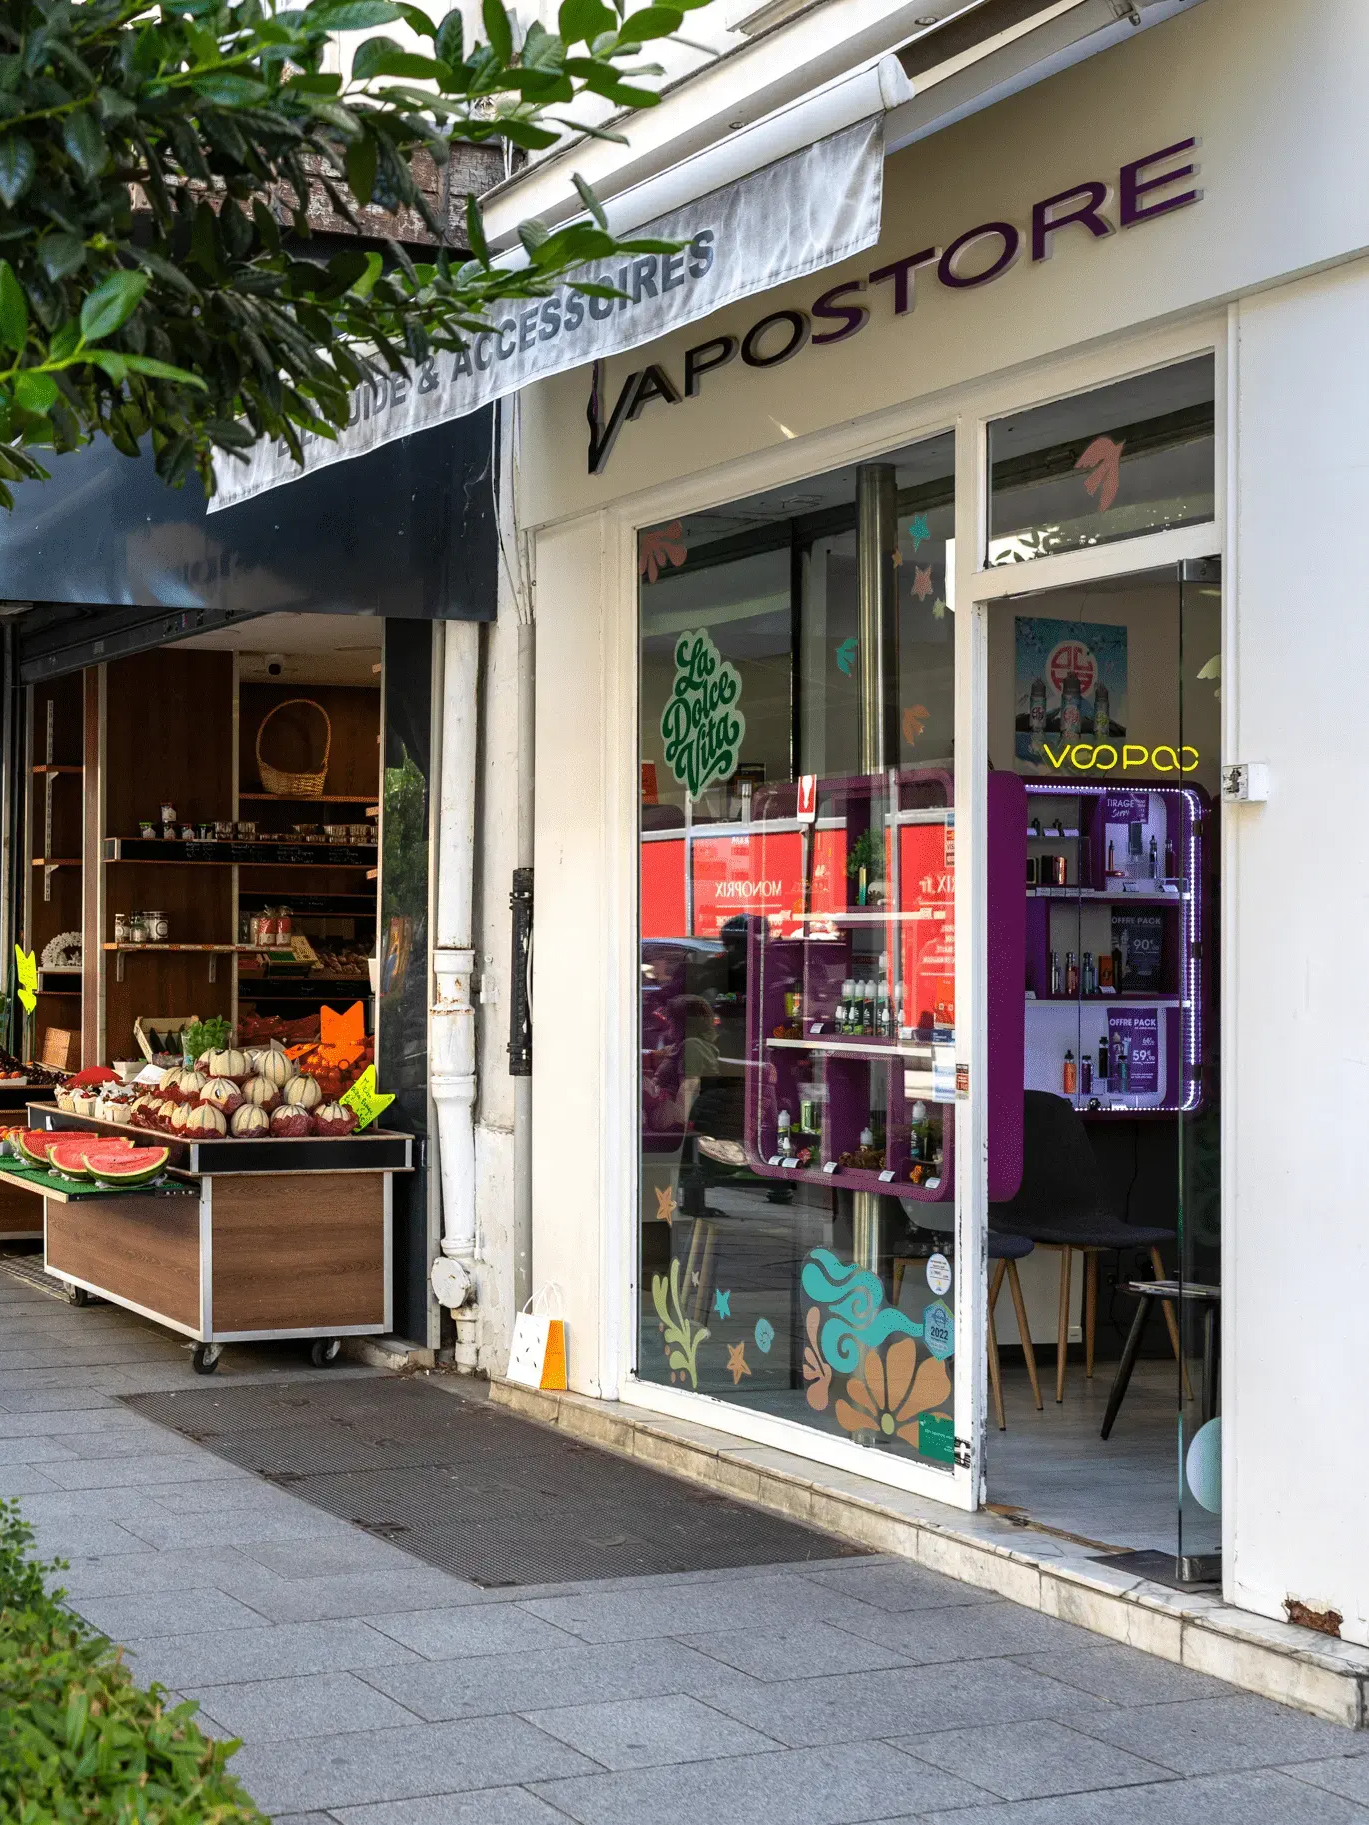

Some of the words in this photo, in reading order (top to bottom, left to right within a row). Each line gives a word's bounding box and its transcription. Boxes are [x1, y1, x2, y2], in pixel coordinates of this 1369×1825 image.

[417, 364, 441, 394] &
[451, 228, 715, 384] ACCESSOIRES
[587, 136, 1204, 476] VAPOSTORE
[676, 637, 715, 697] La
[662, 671, 737, 762] Dolce
[674, 711, 740, 797] Vita
[1111, 916, 1135, 925] OFFRE
[1137, 917, 1161, 926] PACK
[1109, 1018, 1133, 1027] OFFRE
[1134, 1018, 1156, 1027] PACK
[930, 1326, 949, 1341] 2022
